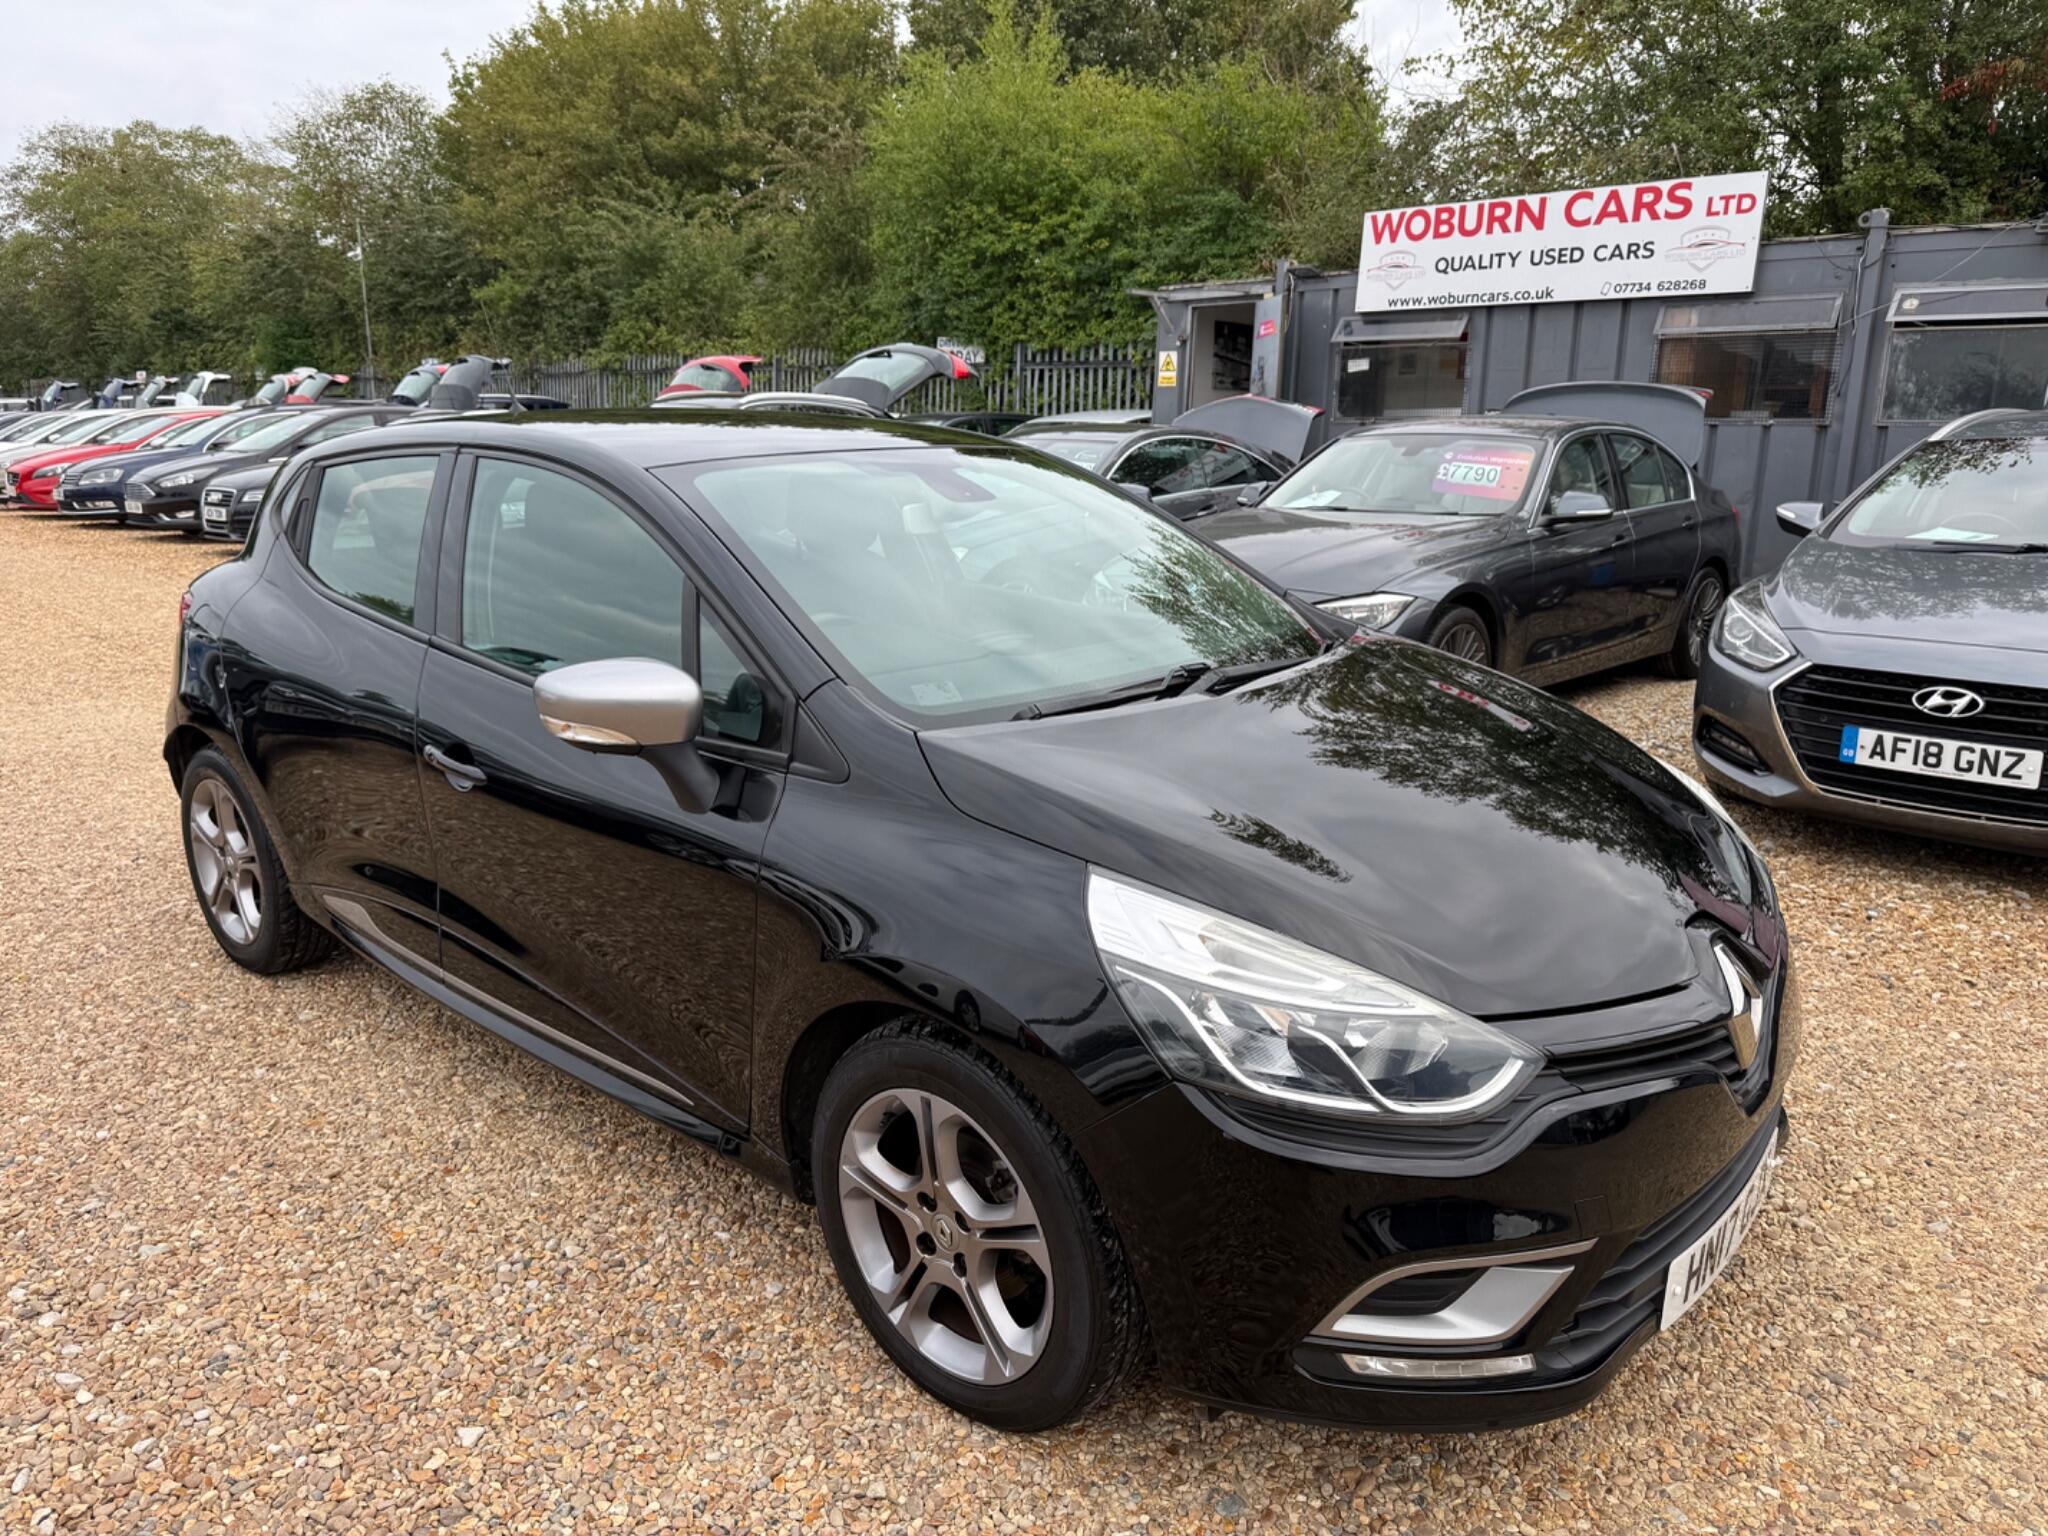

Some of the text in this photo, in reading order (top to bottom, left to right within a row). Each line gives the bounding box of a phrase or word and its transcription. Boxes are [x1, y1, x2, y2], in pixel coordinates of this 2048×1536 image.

[1371, 181, 1757, 245] WOBURN CARS LTD
[1435, 251, 1522, 274] QUALITY
[1529, 247, 1585, 266] USED
[1593, 241, 1655, 262] CARS
[1387, 287, 1554, 307] www.woburncars.co.uk
[1614, 279, 1707, 294] 07734 628268
[1436, 463, 1498, 483] £7790
[1868, 734, 2026, 780] AF18 GNZ
